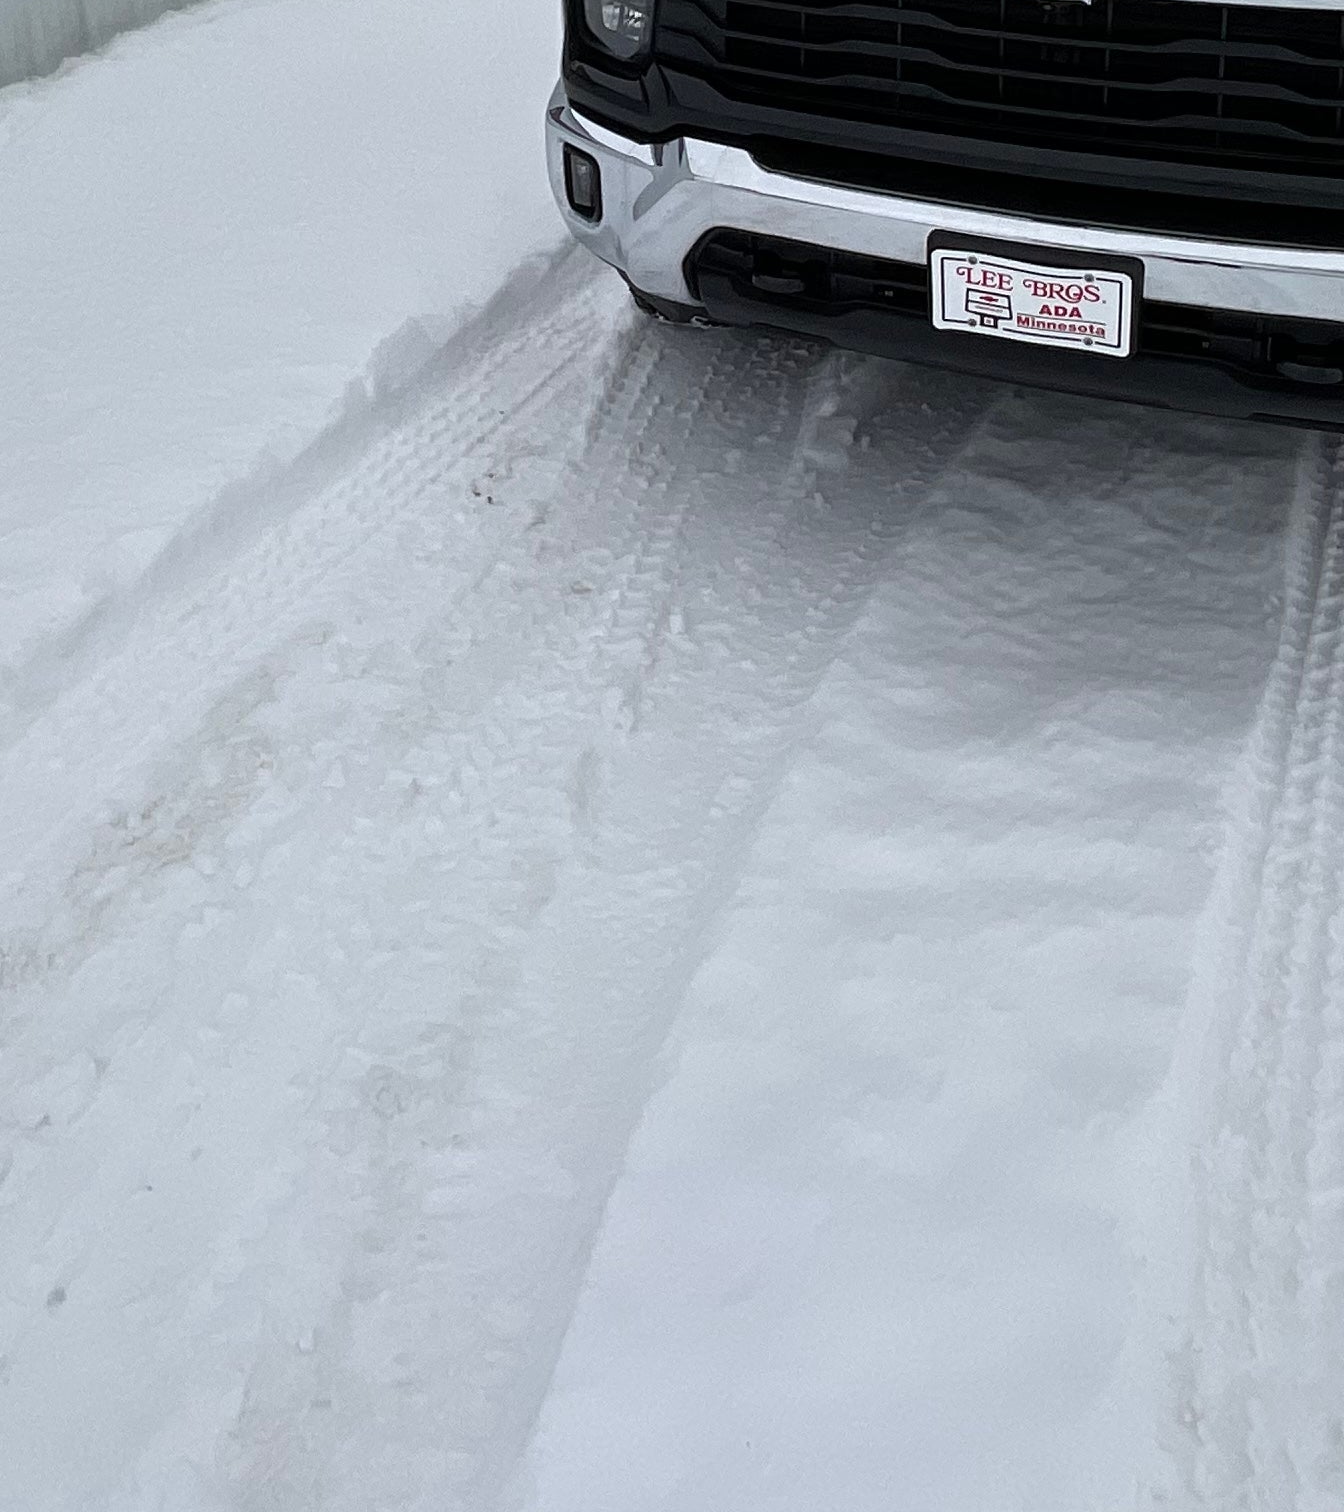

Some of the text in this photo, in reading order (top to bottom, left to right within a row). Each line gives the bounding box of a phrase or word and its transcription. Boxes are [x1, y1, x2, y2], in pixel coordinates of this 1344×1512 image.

[956, 266, 1014, 291] LEE
[1038, 304, 1083, 318] ADA
[1016, 315, 1106, 337] Minnesota
